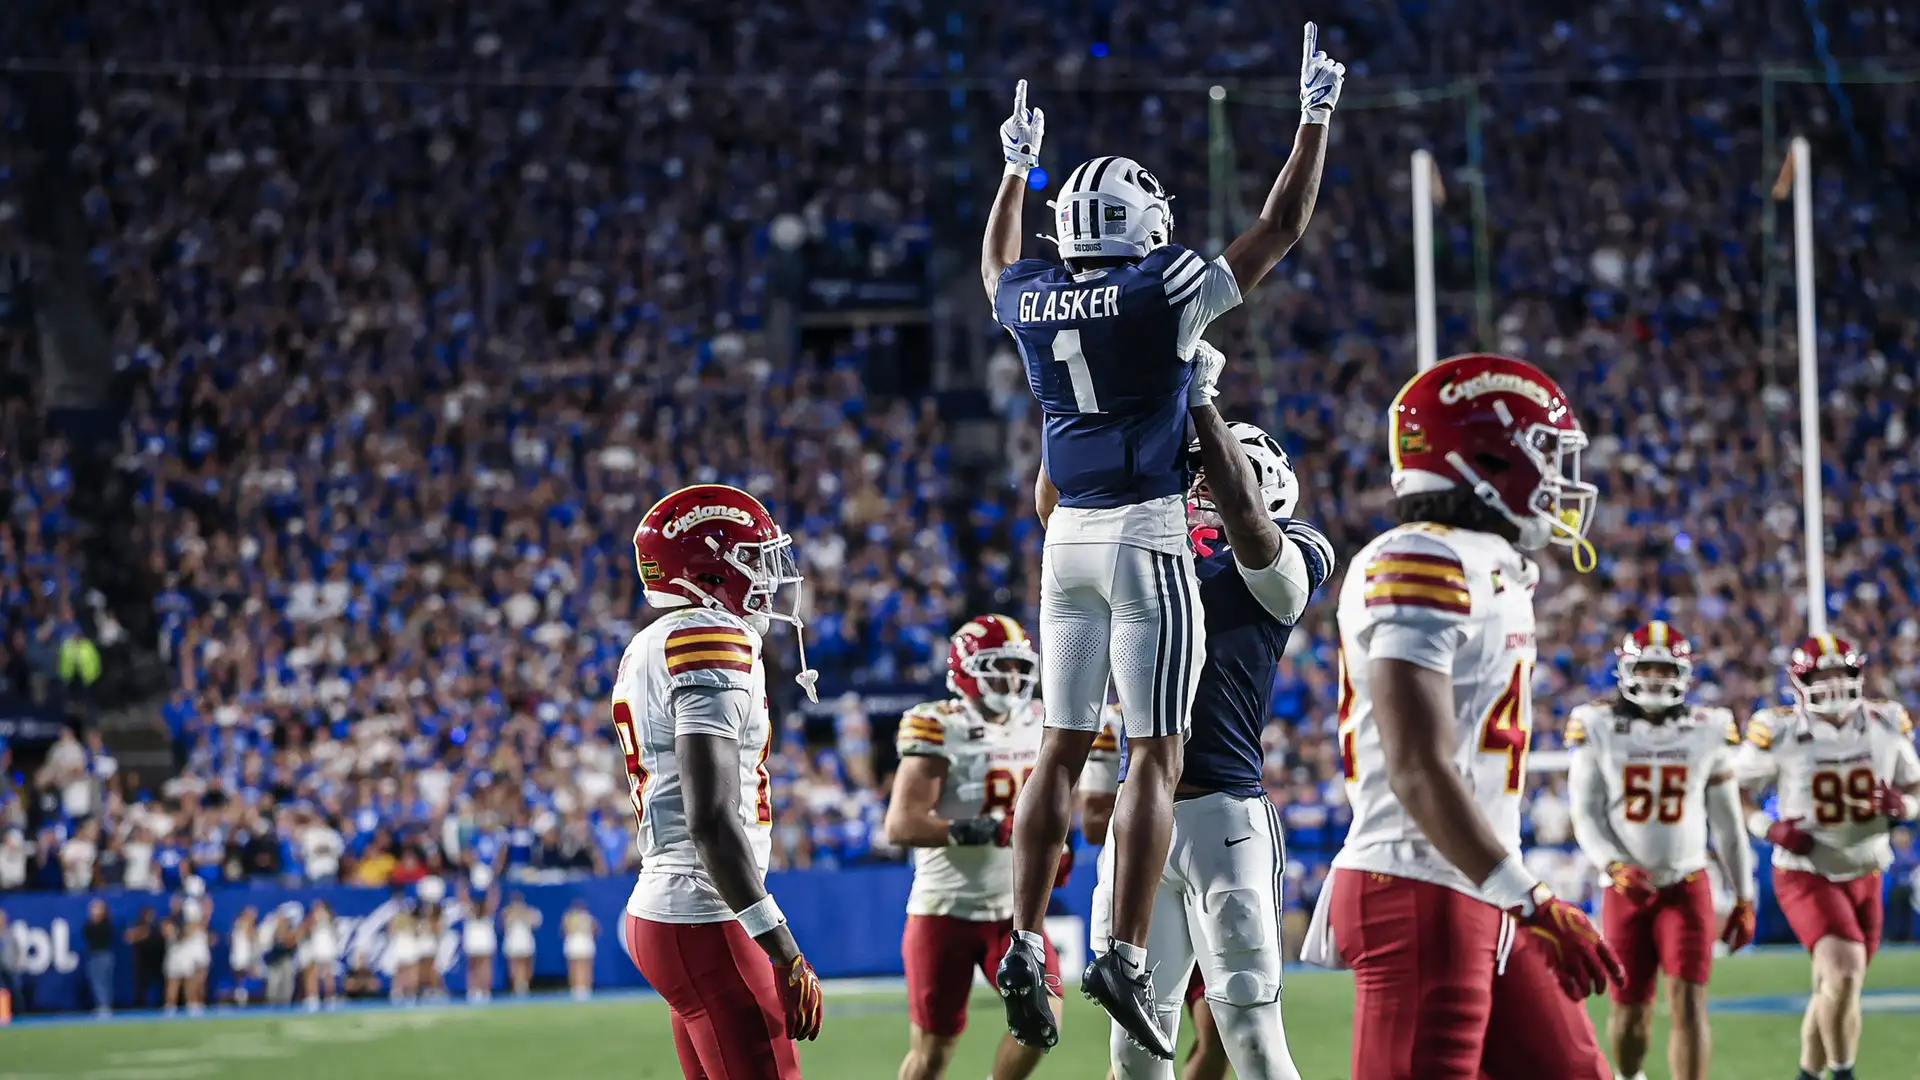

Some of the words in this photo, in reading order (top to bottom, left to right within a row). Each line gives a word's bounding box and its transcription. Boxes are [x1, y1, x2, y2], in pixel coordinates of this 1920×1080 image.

[1019, 285, 1119, 323] GLASKER
[1051, 328, 1108, 414] 1
[1439, 370, 1549, 405] Cyclones
[662, 504, 755, 540] Cyclones
[1623, 763, 1689, 825] 55
[1812, 767, 1877, 829] 99
